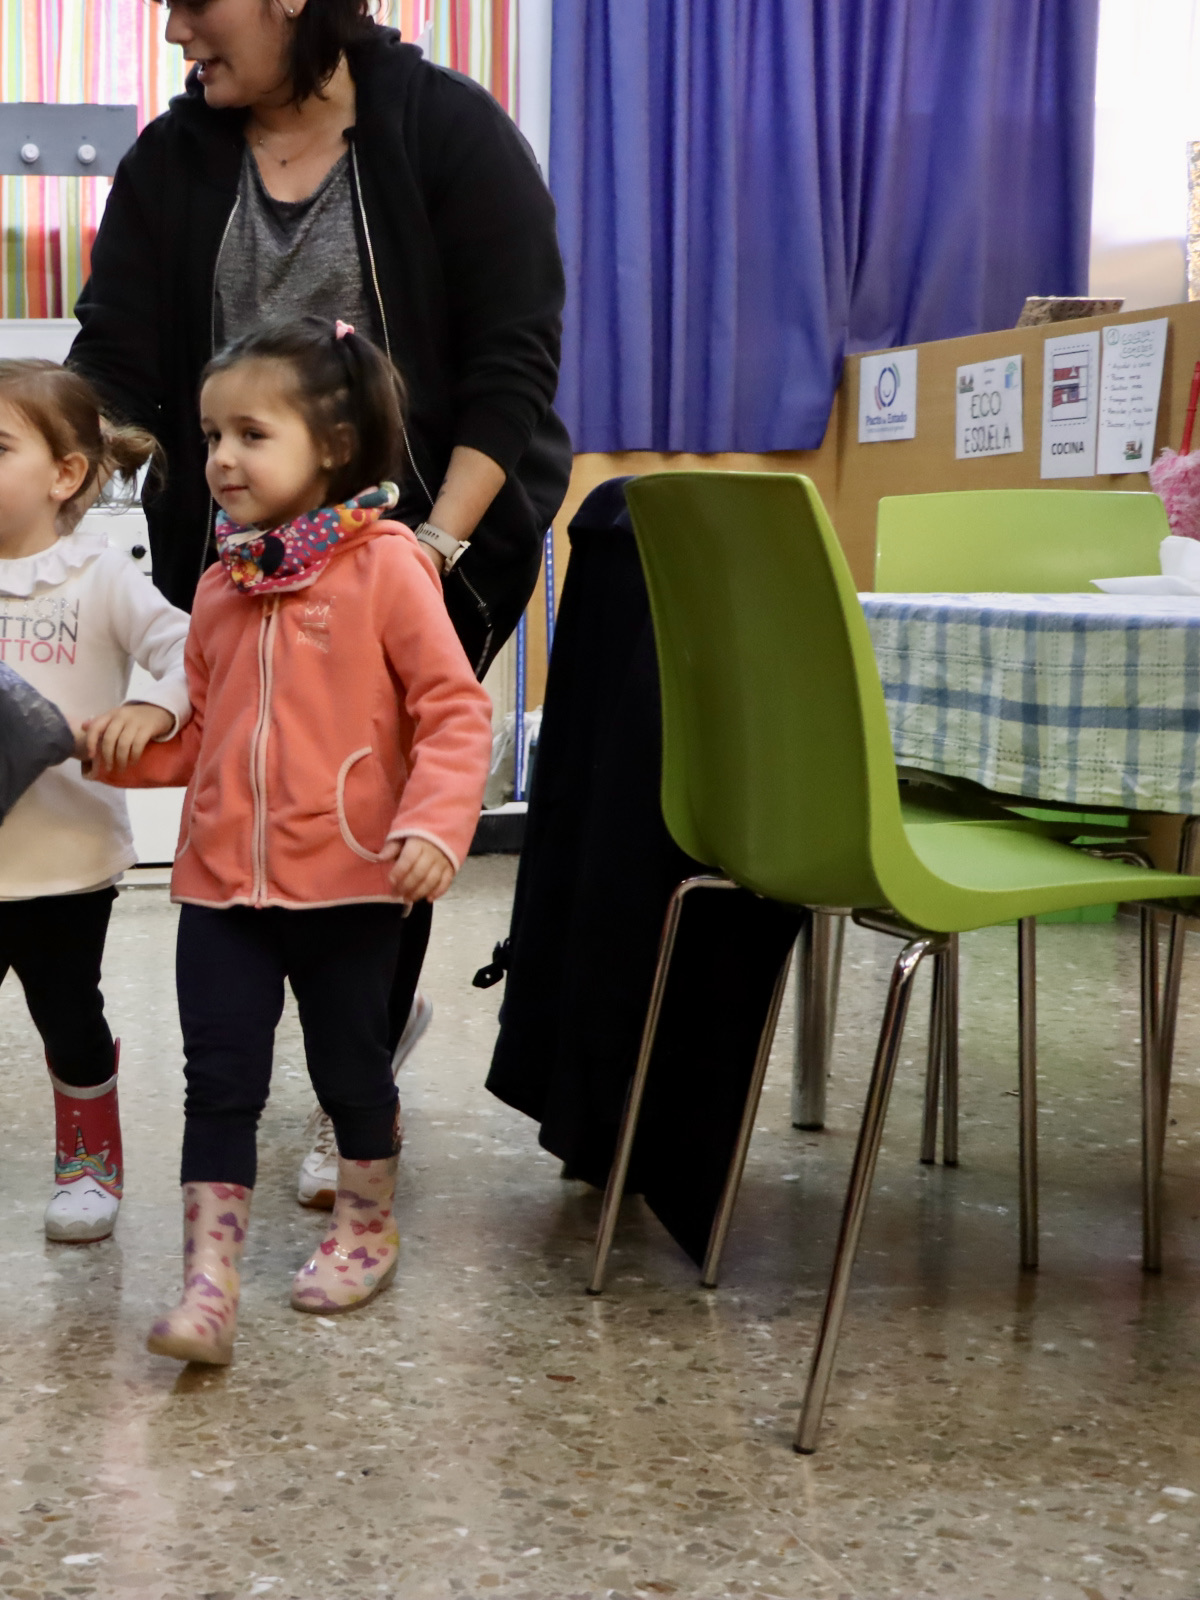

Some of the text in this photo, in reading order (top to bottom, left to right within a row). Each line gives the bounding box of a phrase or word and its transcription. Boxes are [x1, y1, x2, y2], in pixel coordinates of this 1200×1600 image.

[971, 391, 1002, 419] ECO
[964, 423, 1012, 454] ESCUELA
[1051, 441, 1085, 455] COCINA
